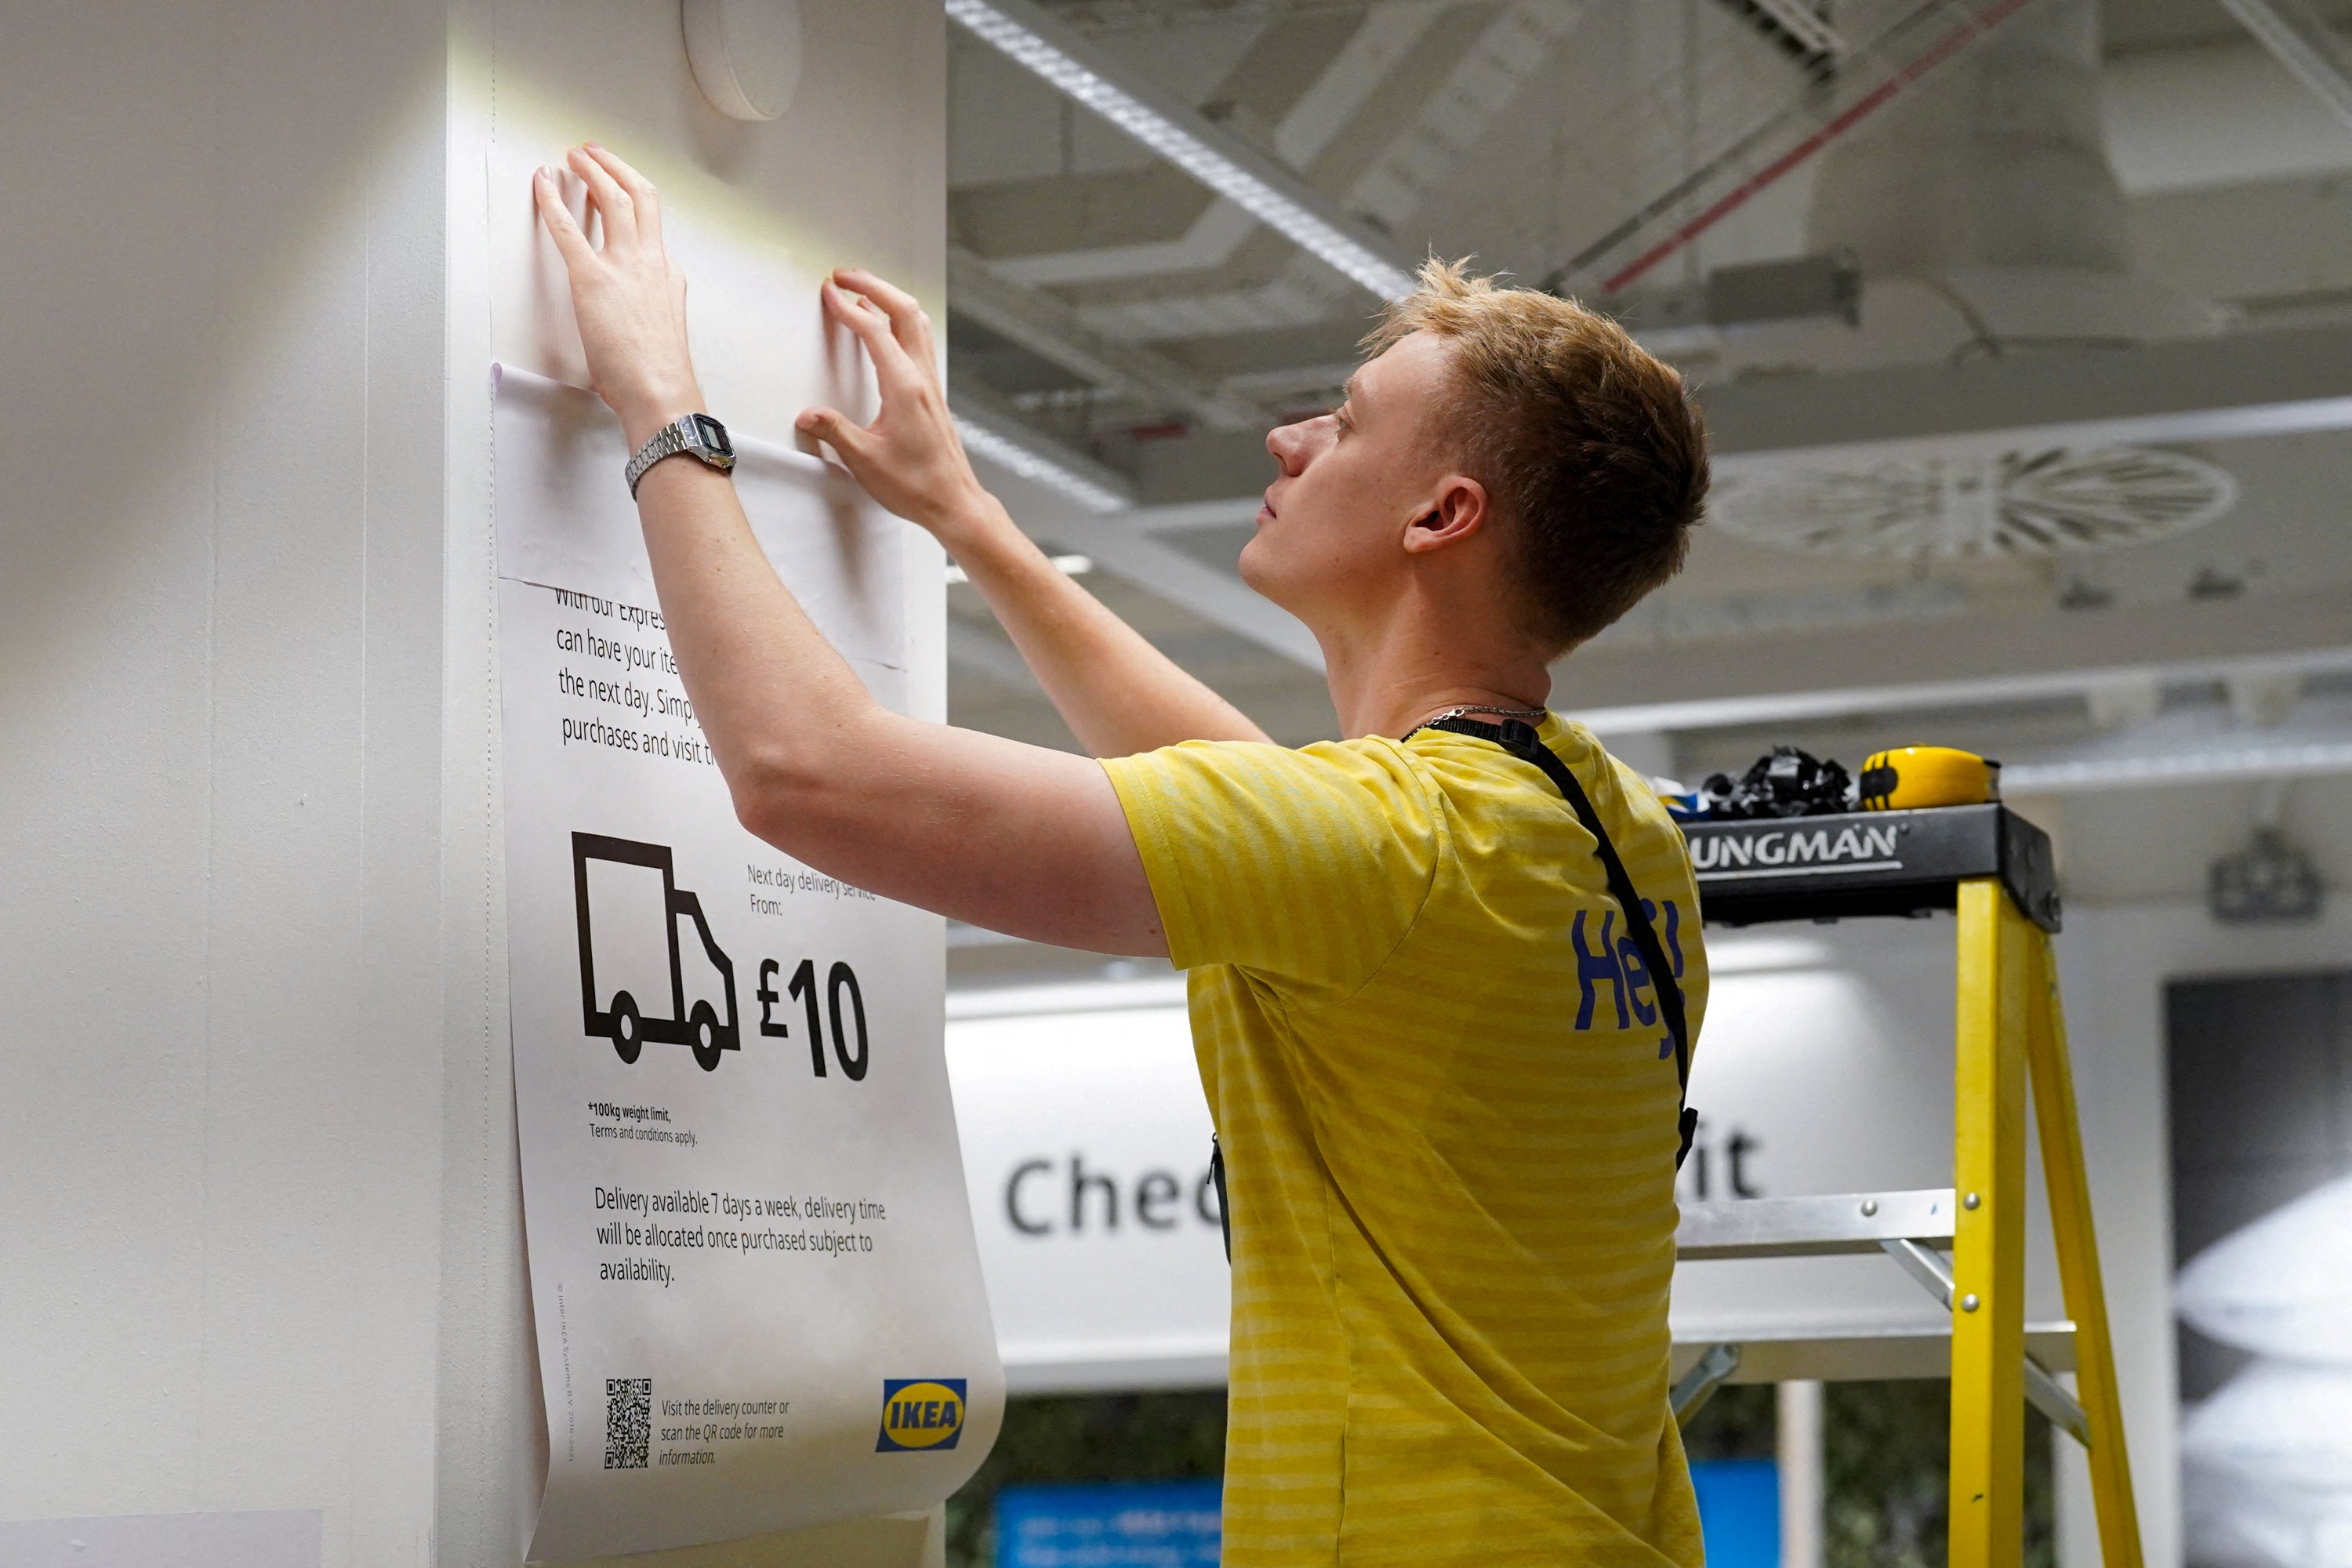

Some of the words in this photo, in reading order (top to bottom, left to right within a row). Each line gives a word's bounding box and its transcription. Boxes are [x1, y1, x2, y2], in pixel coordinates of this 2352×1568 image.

[557, 629, 583, 653] can
[587, 628, 621, 662] have
[624, 644, 655, 672] your
[559, 667, 584, 697] the
[589, 679, 621, 705] next
[624, 681, 654, 718] day.
[657, 688, 701, 729] Simp
[562, 717, 638, 751] purchases
[643, 731, 669, 757] and
[672, 735, 702, 764] visit
[747, 864, 773, 886] Next
[775, 868, 795, 894] day
[798, 870, 840, 899] delivery
[750, 894, 783, 916] From:
[757, 958, 869, 1082] £10
[622, 1105, 650, 1123] weight
[650, 1106, 671, 1123] limit,
[589, 1123, 618, 1138] Terms
[619, 1125, 633, 1140] and
[635, 1127, 673, 1143] conditions
[675, 1130, 699, 1148] apply.
[595, 1186, 649, 1218] Delivery
[652, 1190, 710, 1214] available
[711, 1192, 718, 1214] 7
[722, 1192, 752, 1221] days
[755, 1199, 763, 1216] a
[764, 1195, 801, 1220] week,
[804, 1196, 855, 1225] delivery
[859, 1198, 886, 1220] time
[597, 1221, 622, 1245] will
[625, 1221, 642, 1246] be
[645, 1223, 704, 1247] allocated
[707, 1231, 739, 1249] once
[741, 1228, 806, 1255] purchased
[809, 1229, 857, 1258] subject
[859, 1233, 873, 1252] to
[600, 1257, 675, 1288] availability.
[562, 1346, 571, 1388] Systems
[662, 1400, 682, 1417] Visit
[684, 1399, 700, 1416] the
[702, 1399, 740, 1420] delivery
[742, 1400, 778, 1415] counter
[779, 1402, 789, 1414] or
[890, 1401, 956, 1429] IKEA
[661, 1428, 683, 1441] scan
[685, 1424, 701, 1440] the
[703, 1424, 717, 1443] QR
[720, 1423, 742, 1439] code
[744, 1422, 758, 1439] for
[759, 1425, 784, 1439] more
[659, 1449, 716, 1466] information.
